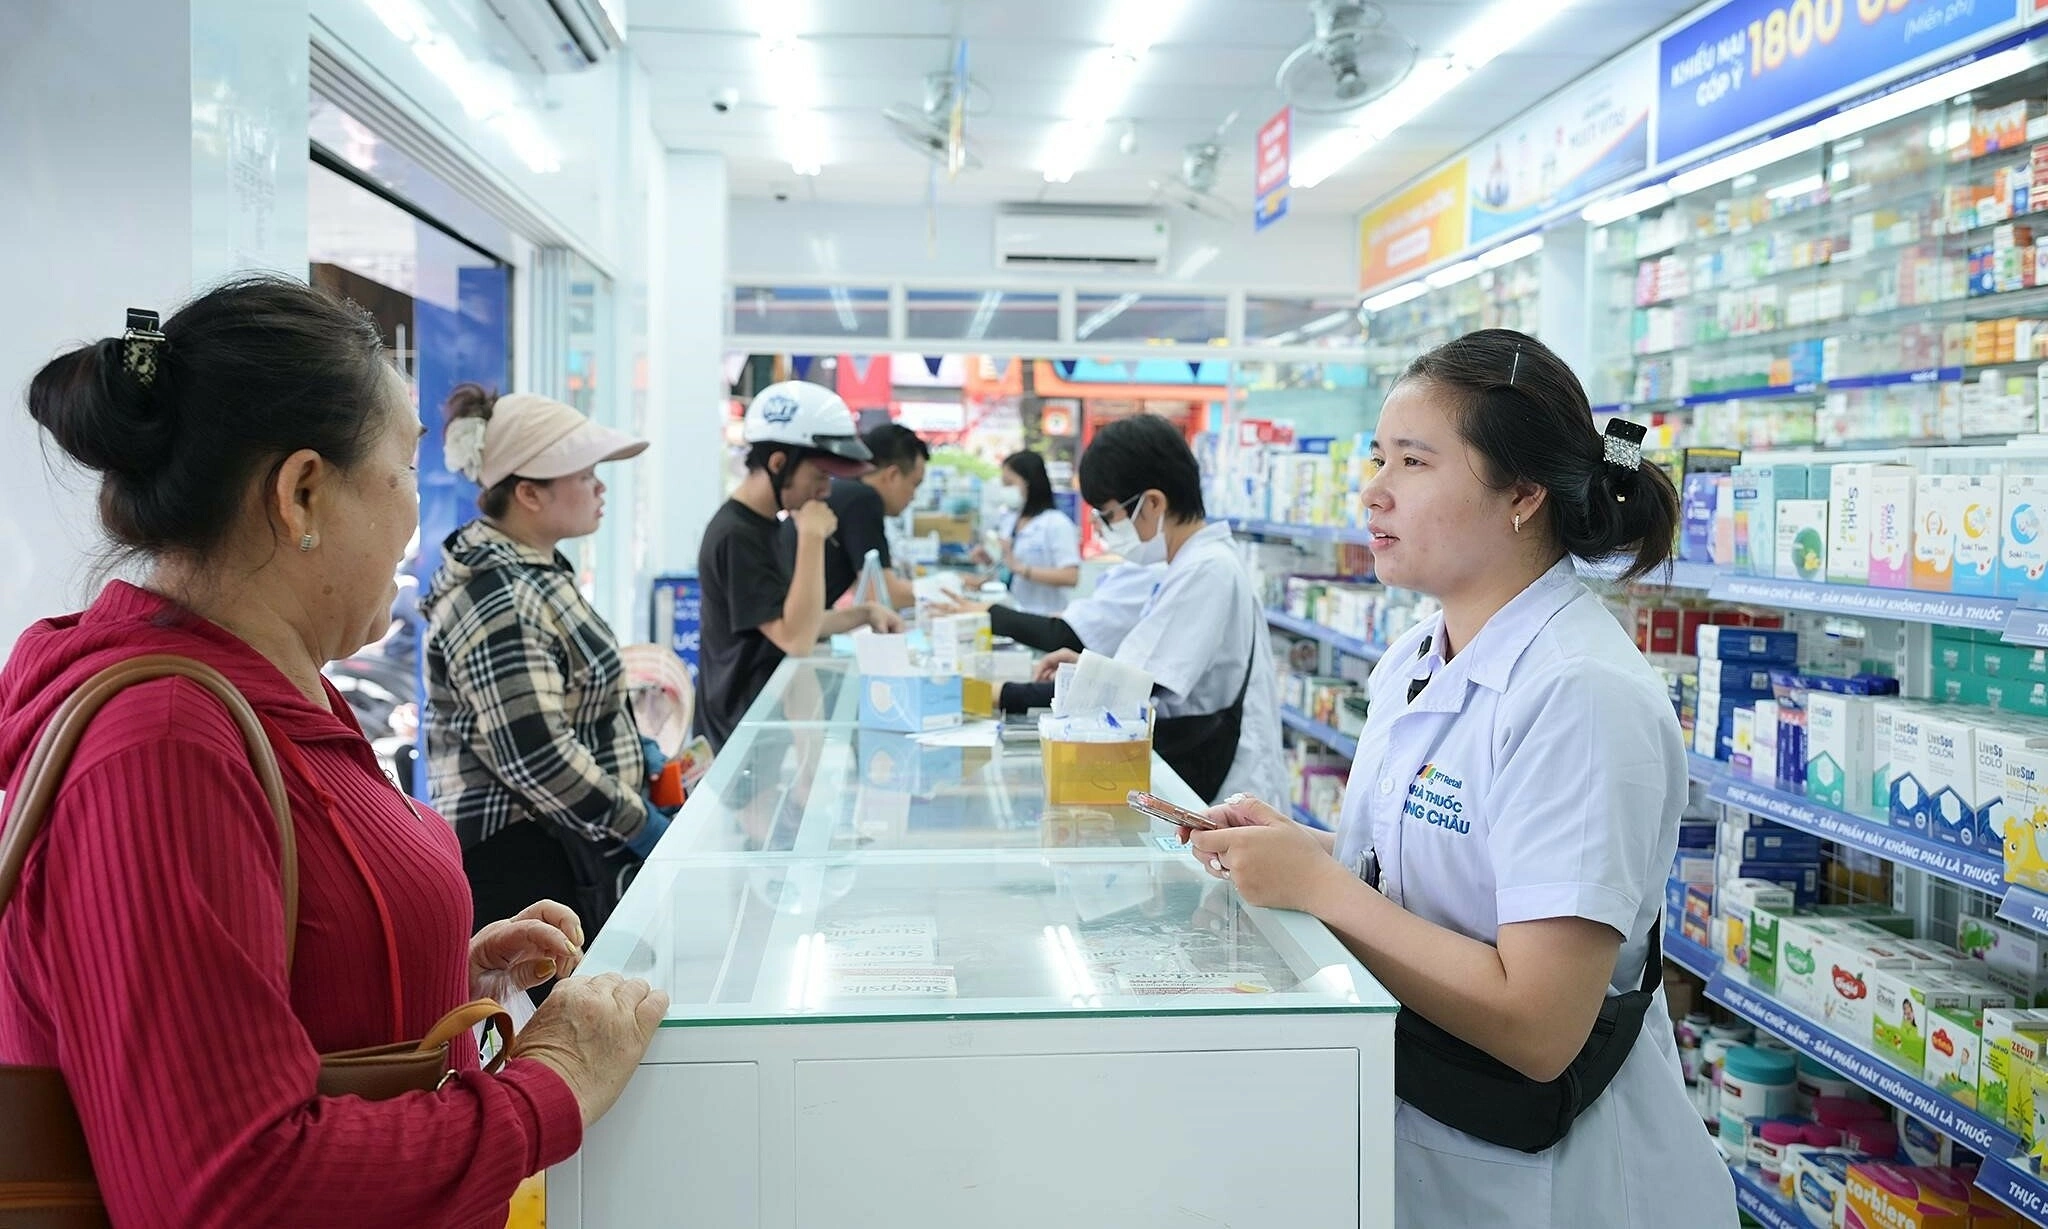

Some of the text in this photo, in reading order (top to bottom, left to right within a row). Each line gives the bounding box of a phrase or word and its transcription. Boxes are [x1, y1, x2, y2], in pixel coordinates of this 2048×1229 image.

[1749, 0, 1843, 78] 1800
[1866, 594, 1887, 608] NÀY
[1886, 598, 1921, 613] KHÔNG
[1923, 601, 1947, 615] PHẢI
[1949, 603, 1963, 617] LÀ
[1966, 605, 2004, 621] THUỐC
[1927, 733, 1953, 748] LiveSpo
[2006, 763, 2035, 780] LiveSpo
[1425, 790, 1463, 813] THUỐC
[1427, 810, 1470, 834] CHÂU
[1819, 815, 1838, 831] SẢN
[1837, 820, 1865, 841] PHẨM
[1864, 831, 1886, 848] NÀY
[1885, 839, 1919, 859] KHÔNG
[1919, 850, 1946, 871] PHẢI
[1945, 857, 1960, 873] LÀ
[1962, 863, 2000, 886] THUỐC
[1786, 1021, 1811, 1045] NĂNG
[1813, 1037, 1834, 1059] SẢN
[1832, 1048, 1860, 1073] PHẨM
[1859, 1063, 1880, 1083] NÀY
[1879, 1076, 1914, 1103] KHÔNG
[1913, 1093, 1938, 1118] PHẢI
[1938, 1110, 1954, 1127] LÀ
[1955, 1118, 1992, 1148] THUỐC
[2009, 1181, 2041, 1210] THỰC
